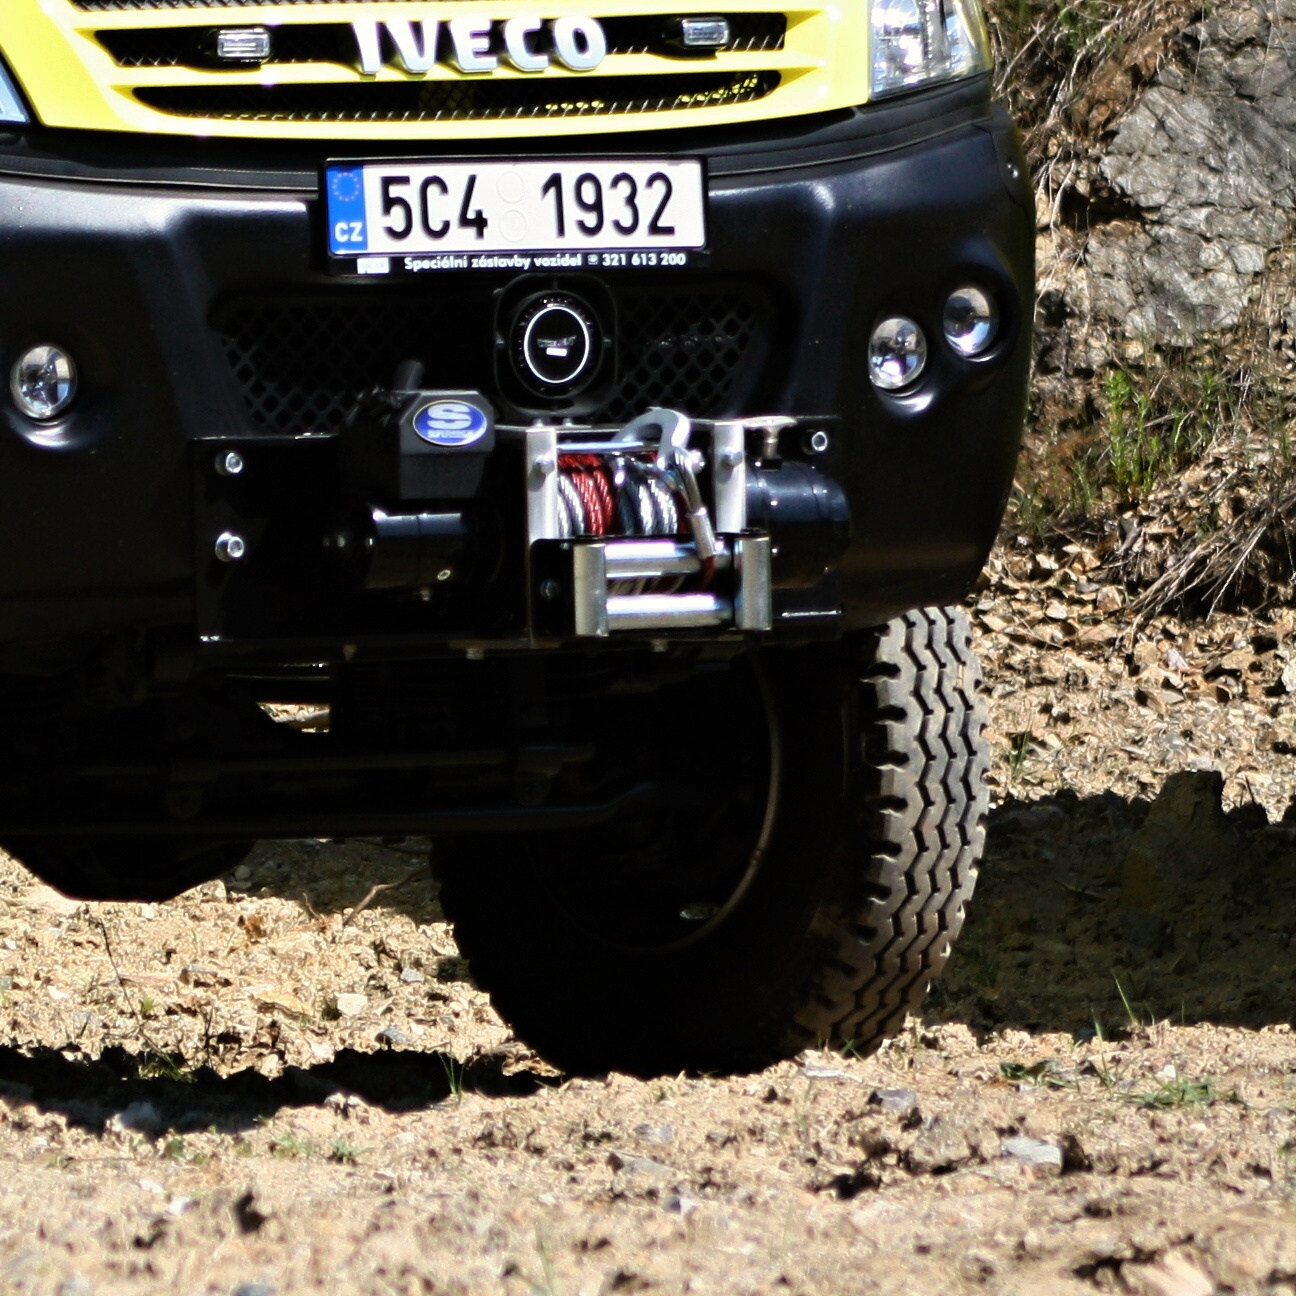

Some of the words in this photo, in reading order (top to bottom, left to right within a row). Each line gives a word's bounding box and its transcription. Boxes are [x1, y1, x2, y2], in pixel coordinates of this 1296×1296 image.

[350, 13, 608, 76] IVECO
[378, 174, 489, 241] 5C4
[540, 171, 676, 238] 1932
[334, 221, 364, 243] CZ
[404, 255, 468, 272] Speciální
[471, 254, 531, 270] zástavby
[533, 253, 583, 267] vozidel
[602, 253, 627, 266] 321
[631, 253, 657, 266] 613
[660, 252, 687, 266] 200
